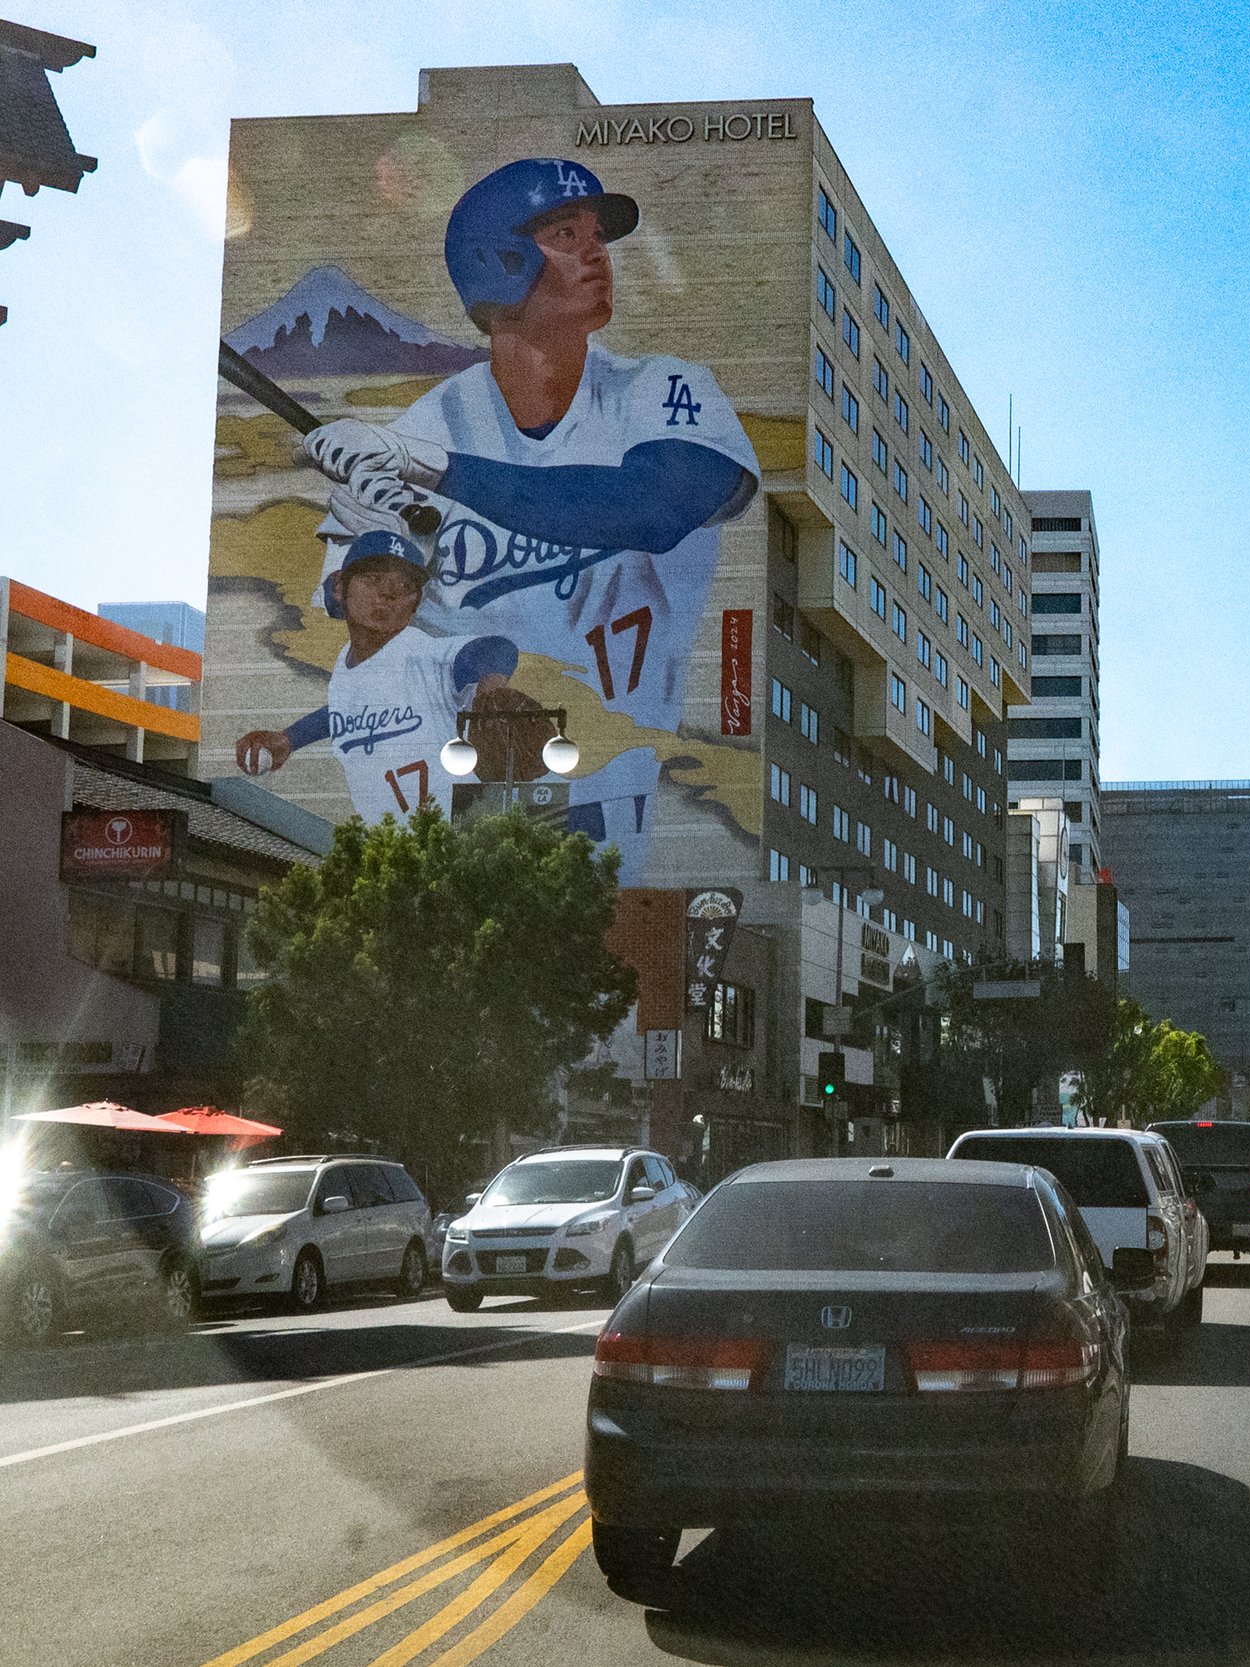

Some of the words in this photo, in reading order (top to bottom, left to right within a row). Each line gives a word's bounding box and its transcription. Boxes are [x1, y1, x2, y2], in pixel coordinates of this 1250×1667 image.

[576, 116, 694, 146] MIYAKO
[704, 113, 797, 141] HOTEL
[553, 160, 588, 197] LA
[662, 374, 702, 426] LA
[389, 535, 405, 558] LA
[585, 606, 652, 700] 17
[730, 617, 739, 650] 2024
[329, 705, 423, 756] Dodgers
[384, 760, 429, 814] 17
[74, 846, 161, 860] CHINCHIKURIN
[688, 927, 724, 1006] 文化堂
[654, 1031, 669, 1078] おみやげ
